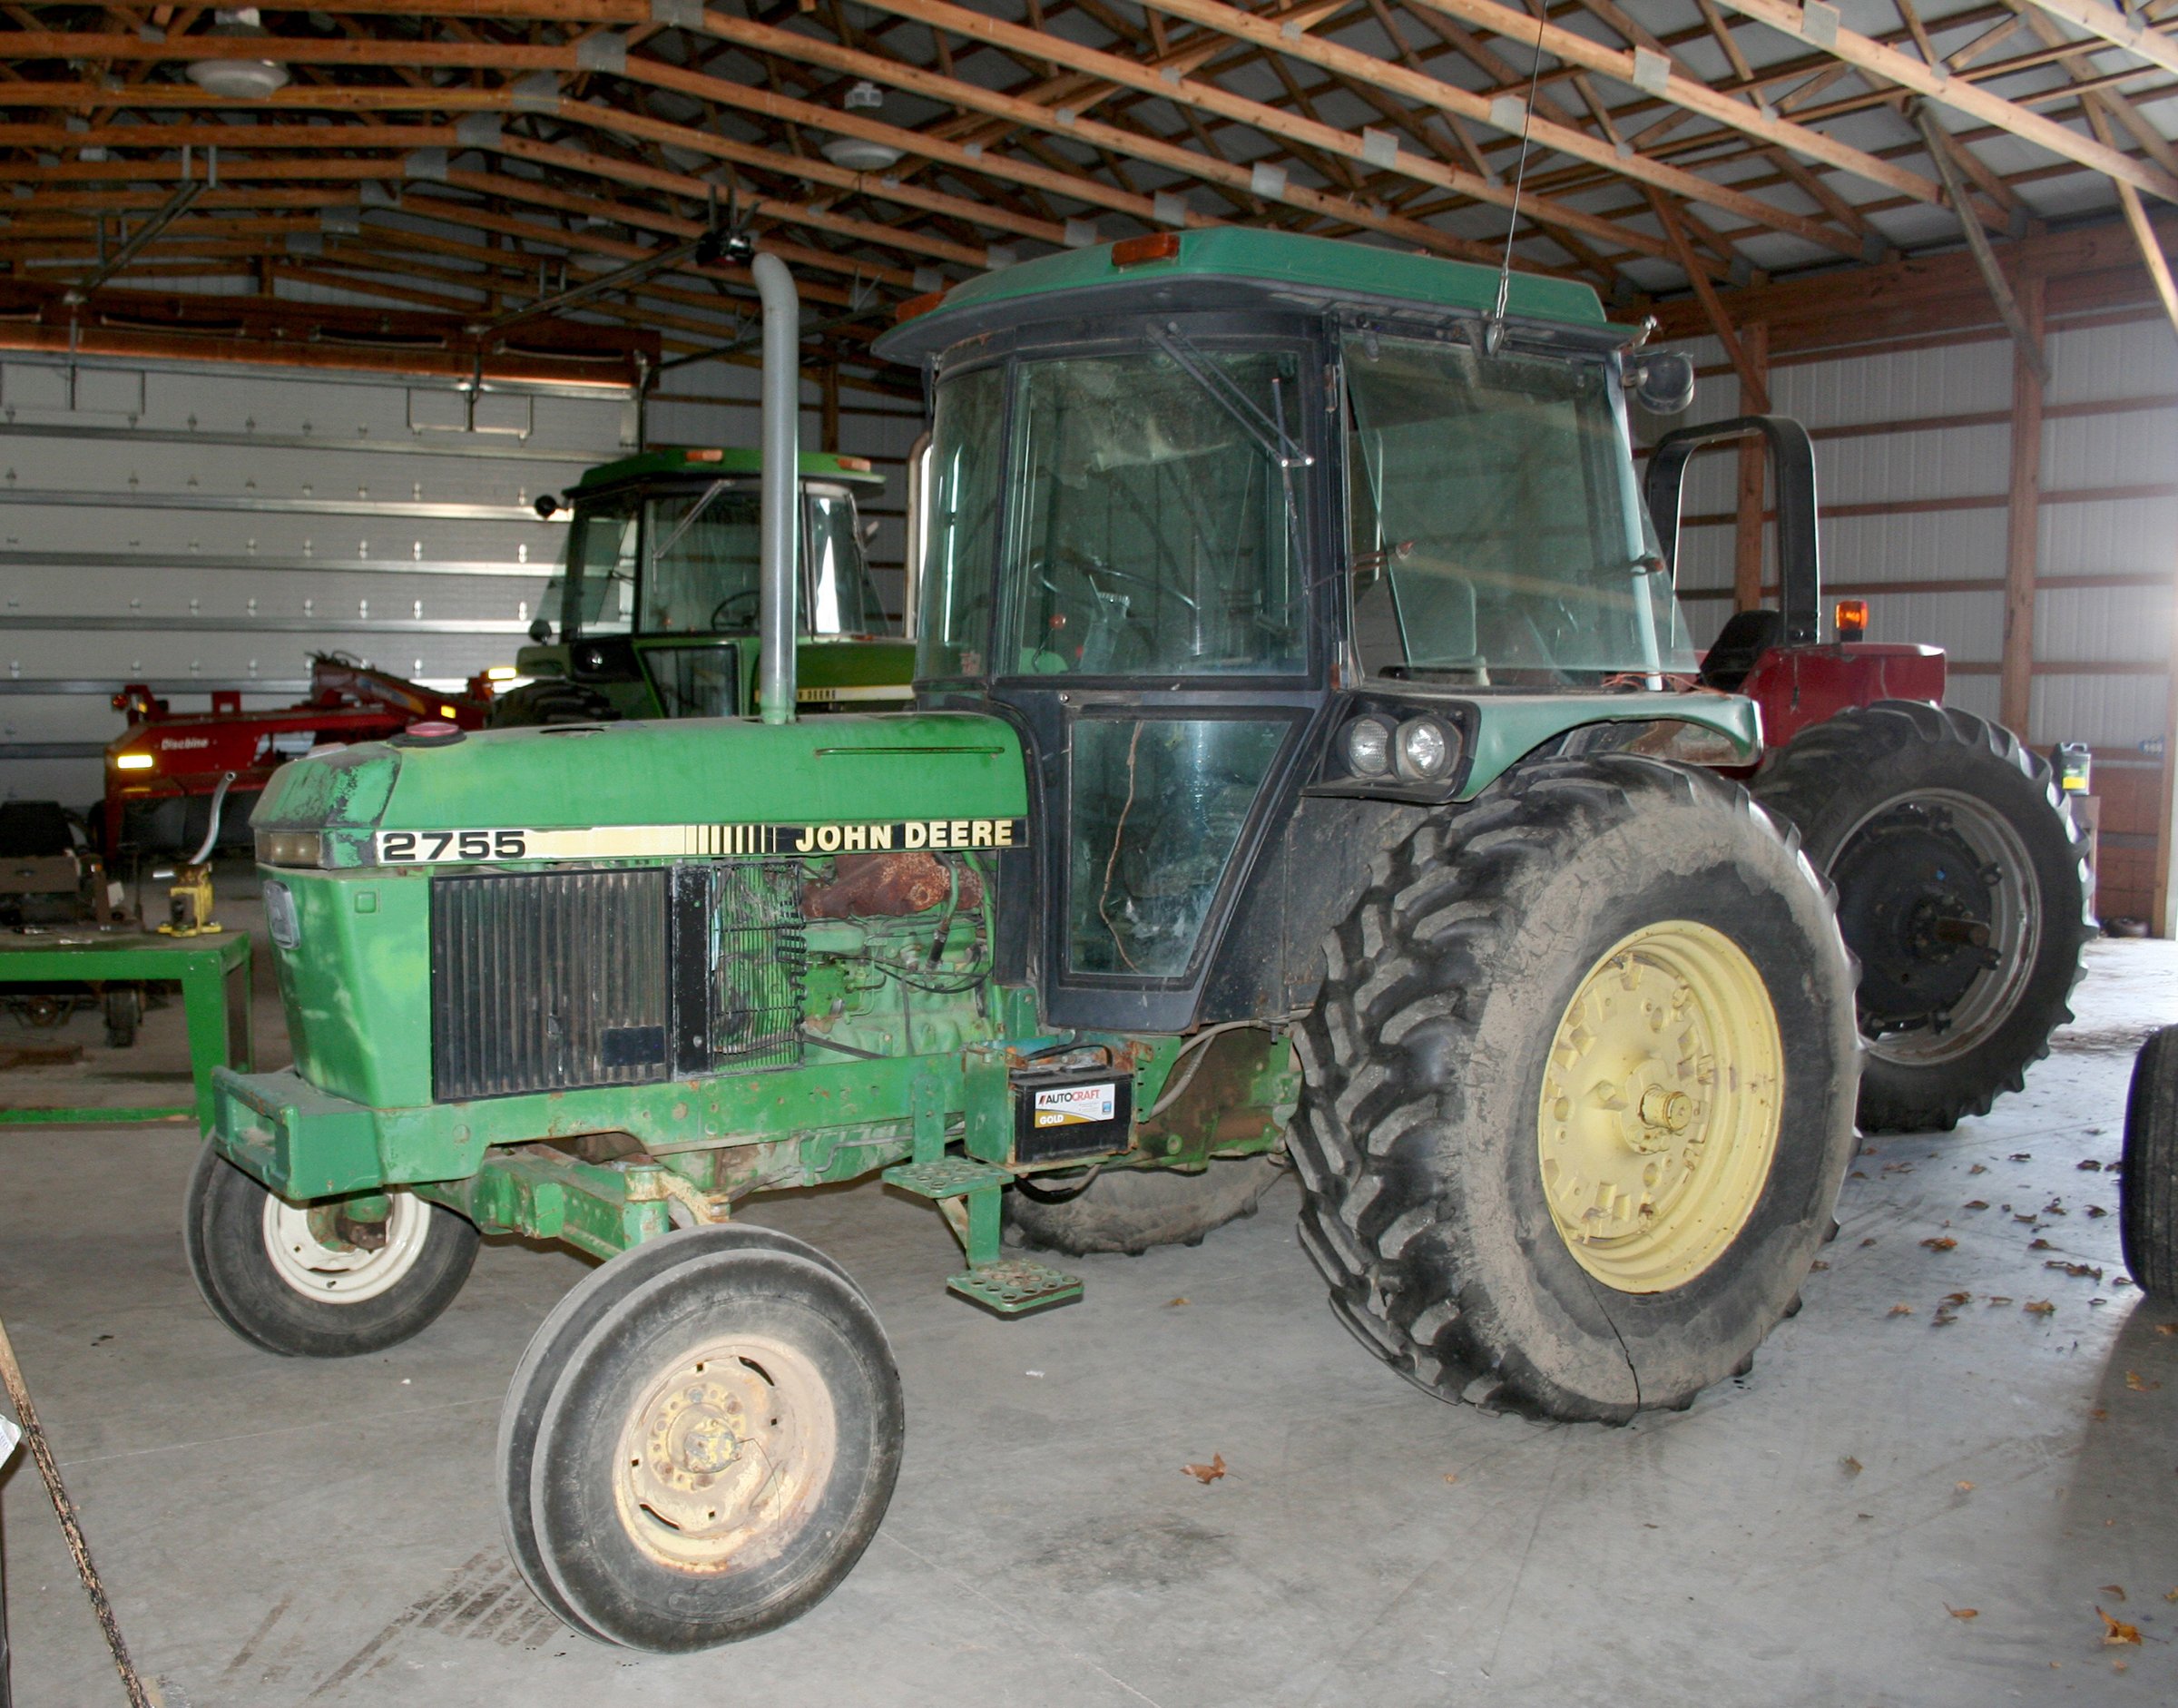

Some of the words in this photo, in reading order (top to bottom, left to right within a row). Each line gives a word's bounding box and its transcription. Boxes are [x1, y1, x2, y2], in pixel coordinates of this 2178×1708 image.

[383, 830, 525, 861] 2755
[795, 824, 892, 852] JOHN
[905, 820, 1013, 849] DEERE
[1045, 1089, 1100, 1104] AUTOCRAFT
[1039, 1114, 1064, 1124] GOLD
